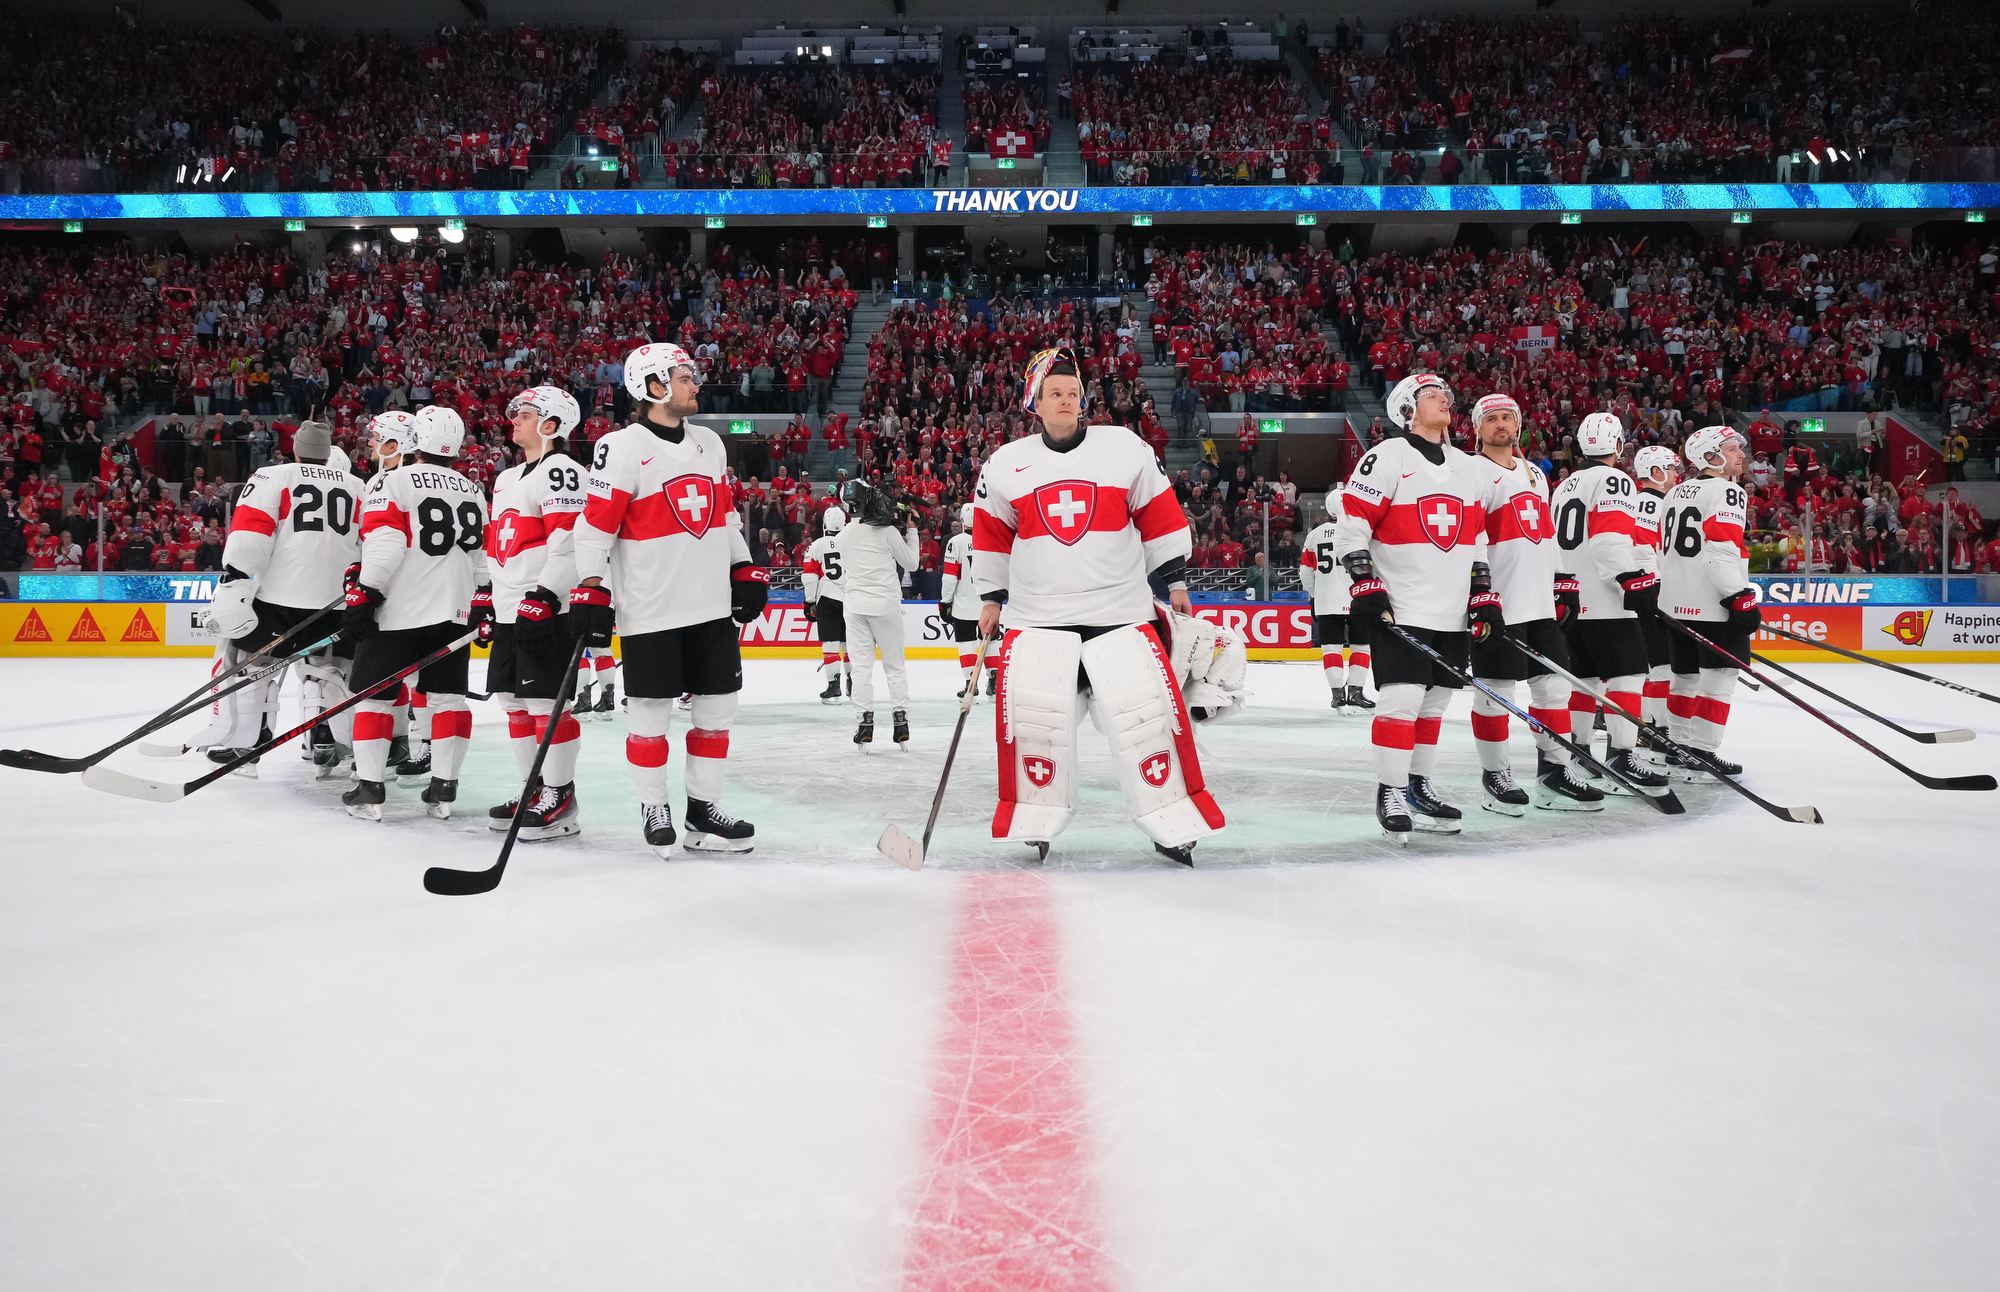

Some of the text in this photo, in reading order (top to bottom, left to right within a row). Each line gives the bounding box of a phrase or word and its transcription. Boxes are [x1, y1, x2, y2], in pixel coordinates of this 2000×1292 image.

[933, 190, 1078, 212] THANK YOU
[1521, 339, 1549, 348] BERN
[1587, 436, 1597, 445] 90
[1905, 444, 1920, 460] F1
[301, 466, 344, 482] BERRA
[1360, 453, 1378, 476] 8
[549, 467, 580, 492] 93
[1351, 480, 1382, 497] TISSOT
[1606, 476, 1631, 497] 90
[1613, 499, 1635, 511] TISSOT
[1638, 501, 1657, 515] 18
[1726, 488, 1745, 510] 86
[292, 484, 353, 536] 20
[417, 496, 484, 557] 88
[1663, 506, 1702, 557] 86
[1768, 582, 1873, 604] SHINE
[1679, 606, 1702, 615] IIHF
[19, 618, 47, 639] Sika
[72, 618, 100, 639] Sika
[125, 618, 153, 639] Sika
[1953, 631, 1969, 644] at
[1929, 677, 1982, 698] CCM
